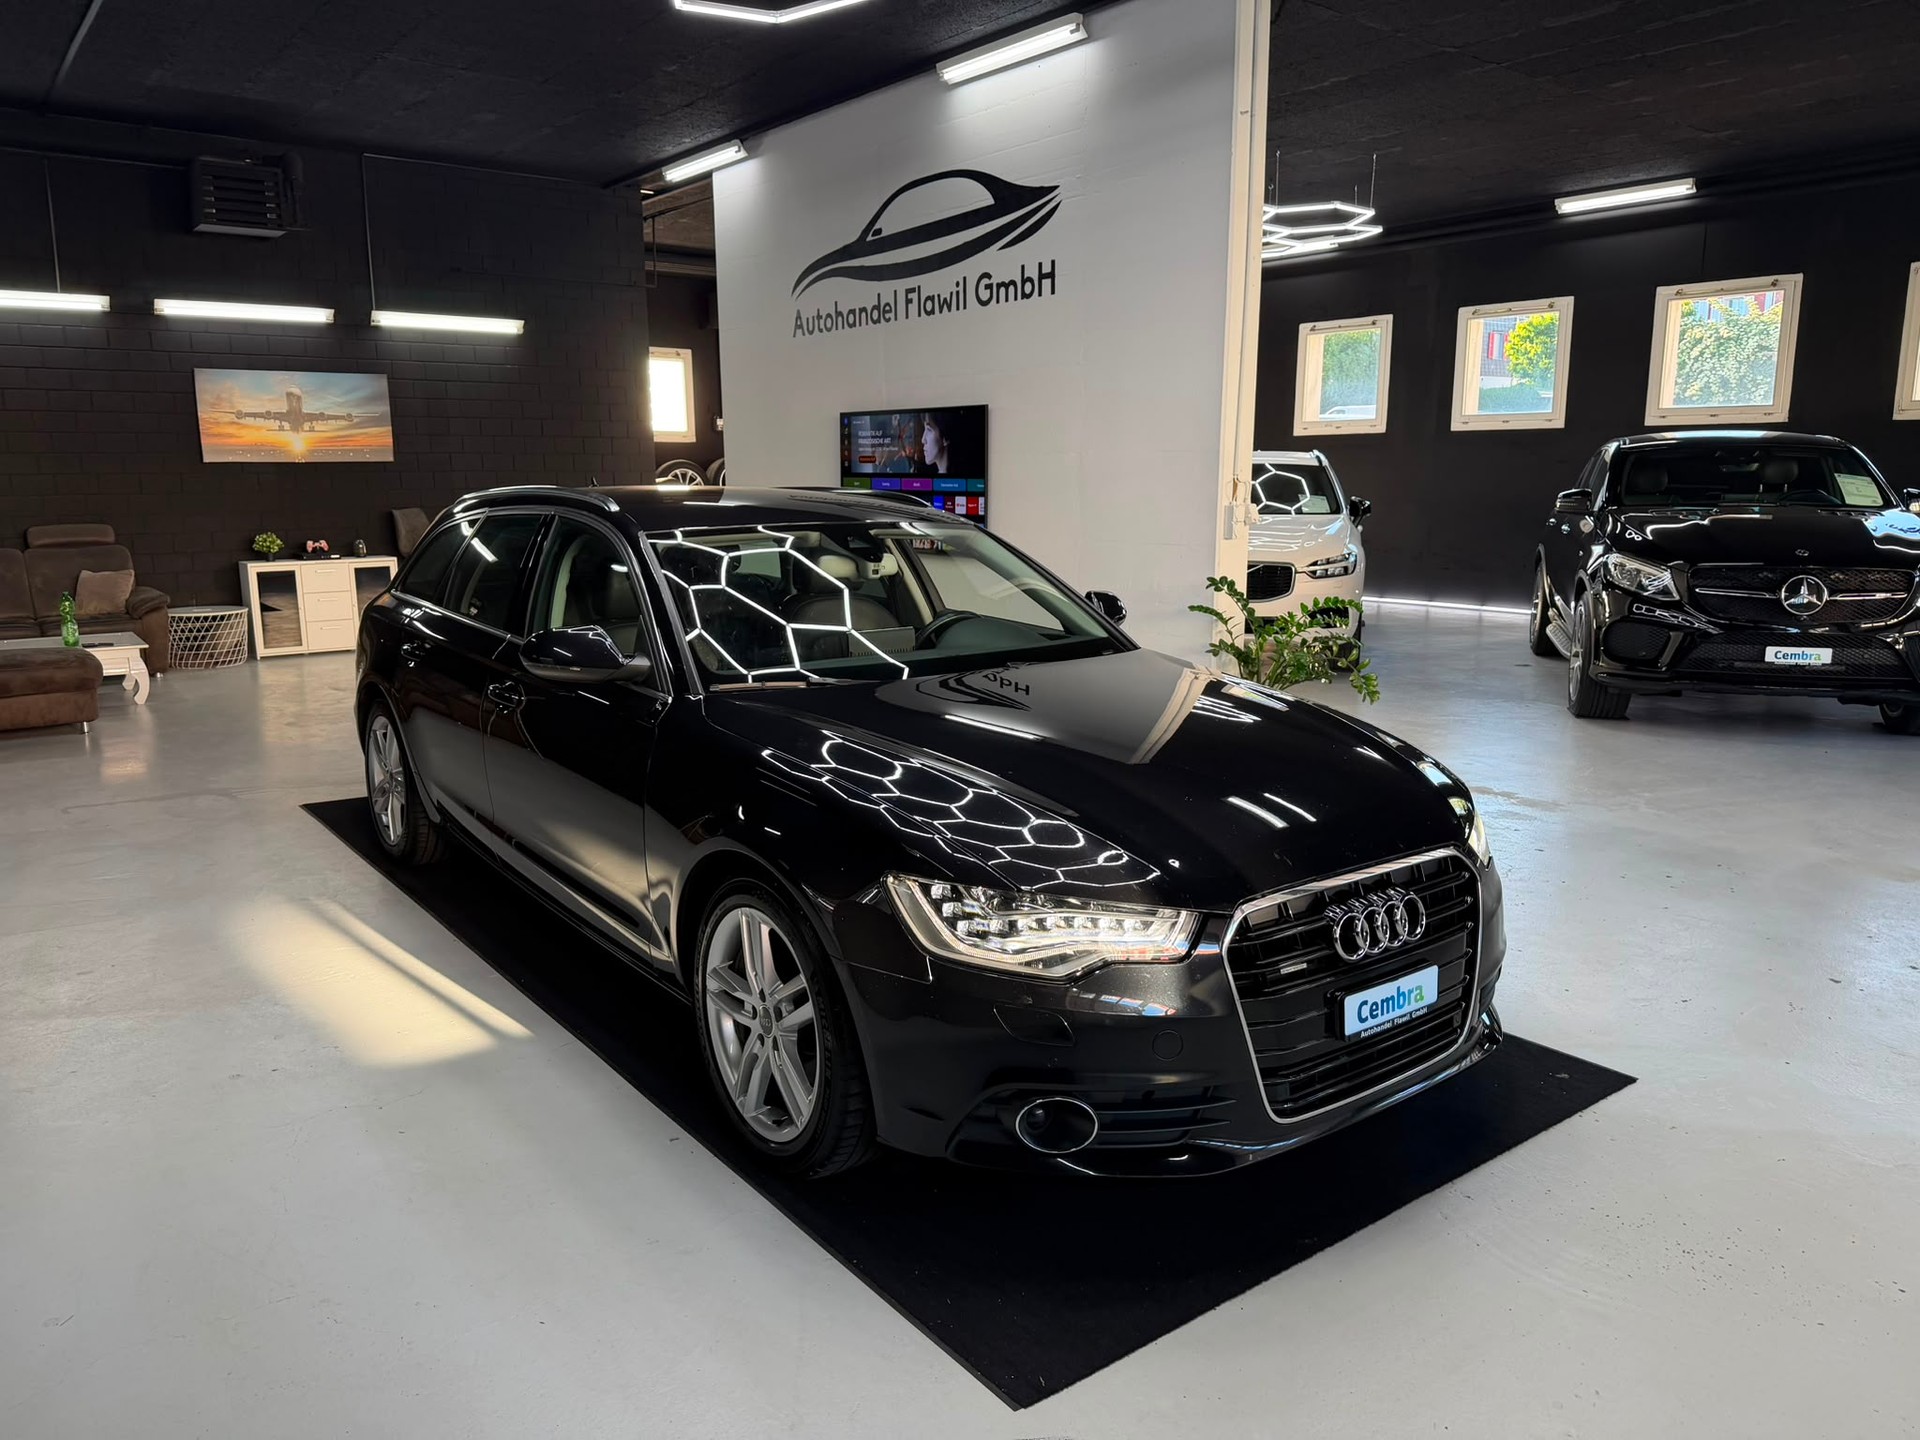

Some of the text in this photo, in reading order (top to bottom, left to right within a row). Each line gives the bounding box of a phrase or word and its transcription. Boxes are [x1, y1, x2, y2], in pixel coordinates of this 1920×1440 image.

[792, 259, 1056, 338] Autohandel Flawil GmbH
[1773, 650, 1821, 661] Cembra
[1357, 985, 1425, 1024] Cembra
[1360, 1006, 1428, 1038] Autohandel Flawil GmbH
